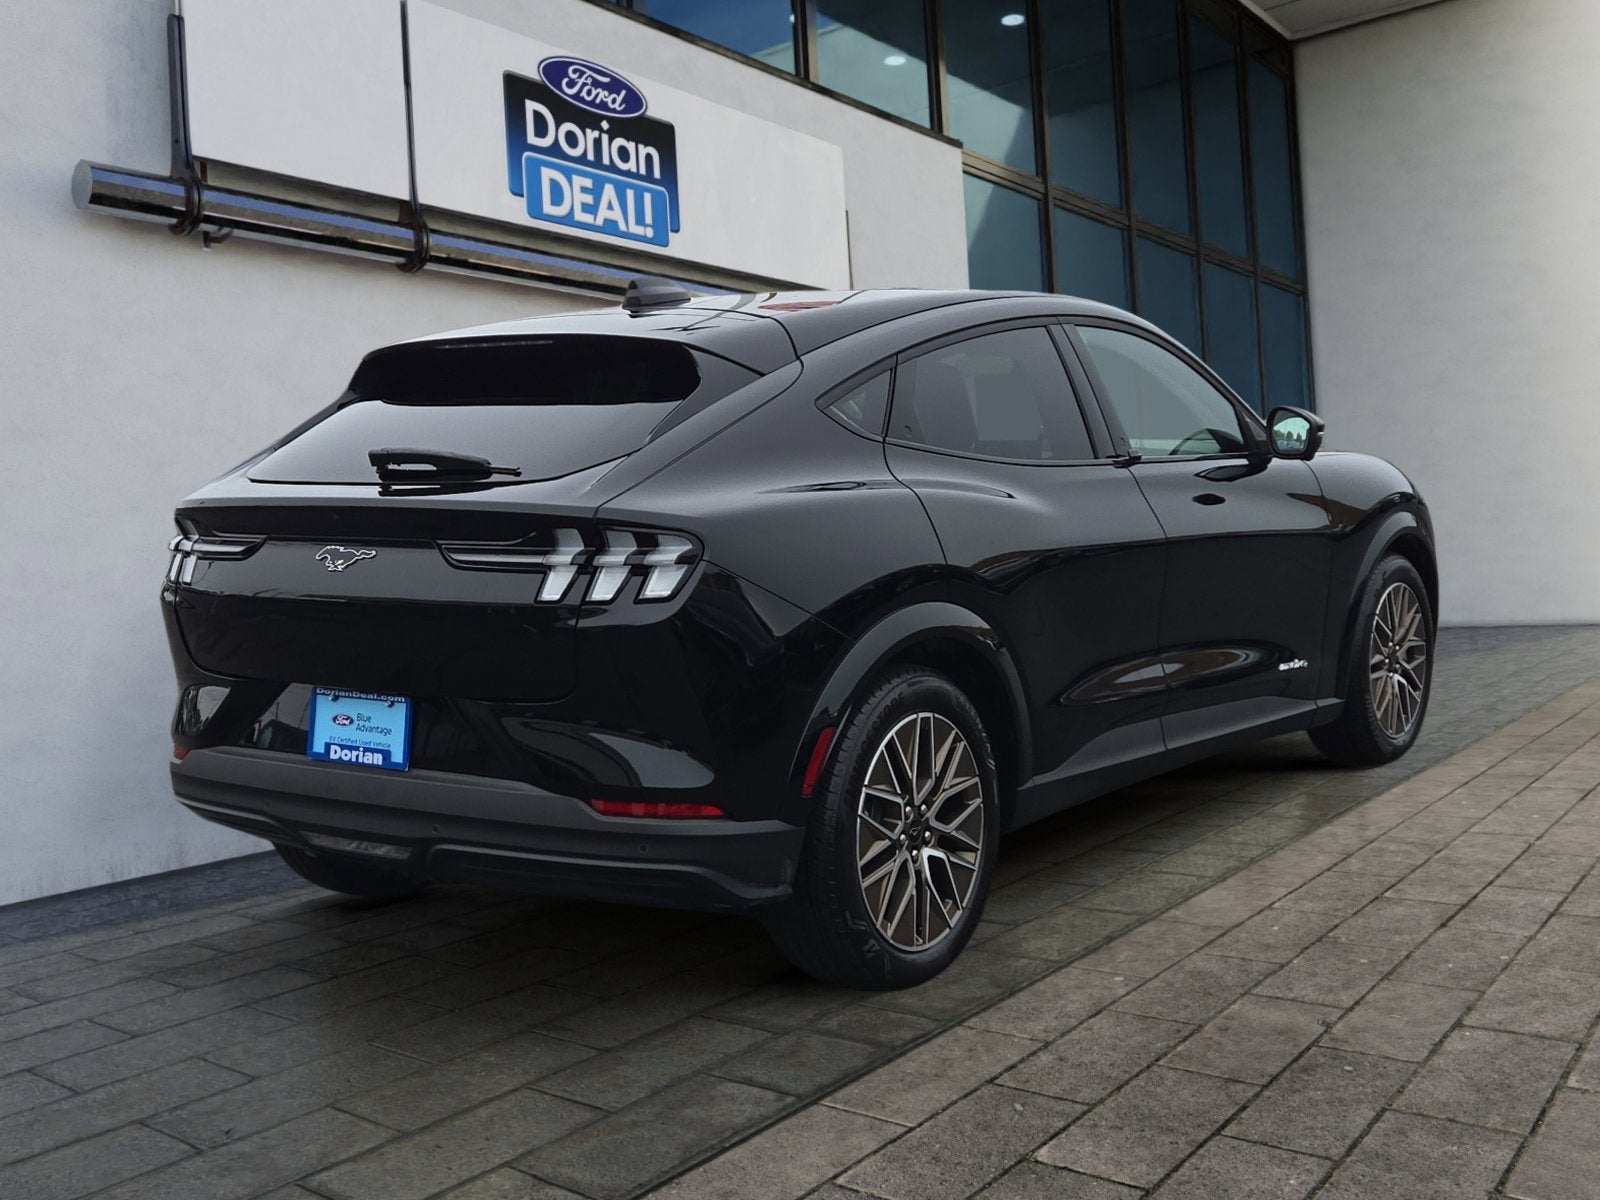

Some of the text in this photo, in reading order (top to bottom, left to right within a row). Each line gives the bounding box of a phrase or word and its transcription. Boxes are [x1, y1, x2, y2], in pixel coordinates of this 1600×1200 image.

[561, 64, 626, 111] Ford
[524, 98, 661, 180] Dorian
[540, 166, 654, 239] DEAL!
[316, 687, 405, 702] DorianDeal.com
[356, 713, 372, 723] Blue
[355, 723, 392, 736] Advantage
[329, 744, 383, 765] Dorian
